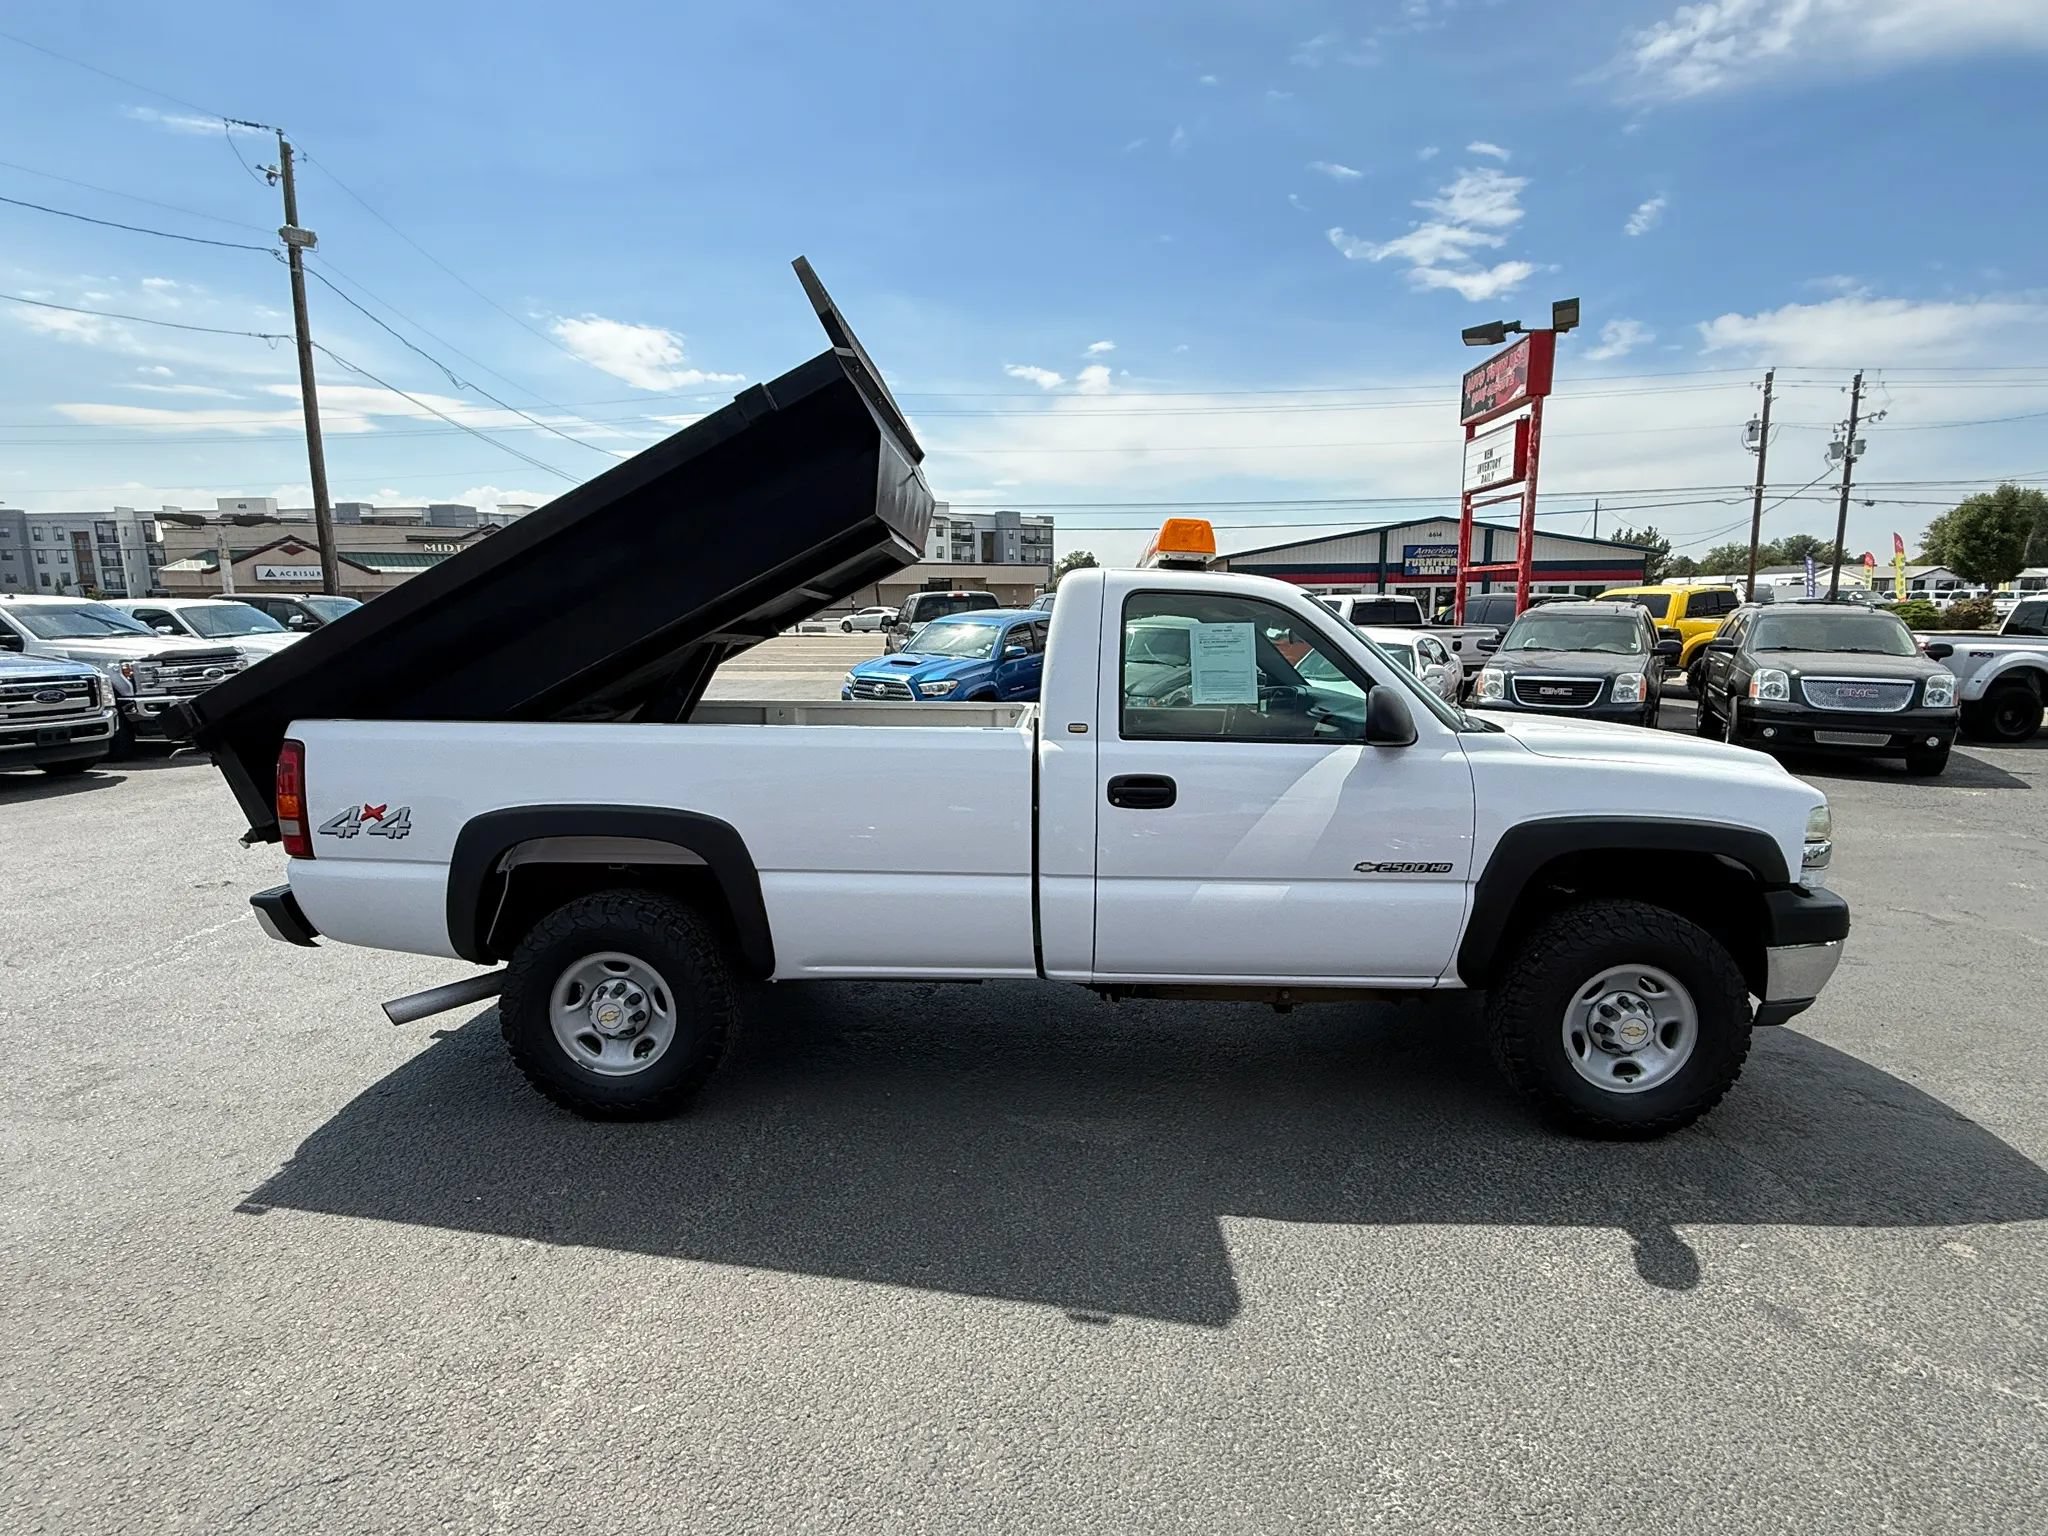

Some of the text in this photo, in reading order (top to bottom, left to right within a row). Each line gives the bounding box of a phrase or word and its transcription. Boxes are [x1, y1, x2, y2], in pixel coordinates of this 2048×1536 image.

[1476, 456, 1502, 475] INVENTORY
[1480, 470, 1495, 484] DAILY
[1413, 546, 1457, 557] American
[1404, 557, 1458, 567] FURNITUR
[1419, 566, 1450, 575] MART
[1539, 686, 1573, 696] GMC
[1836, 687, 1879, 698] GMC
